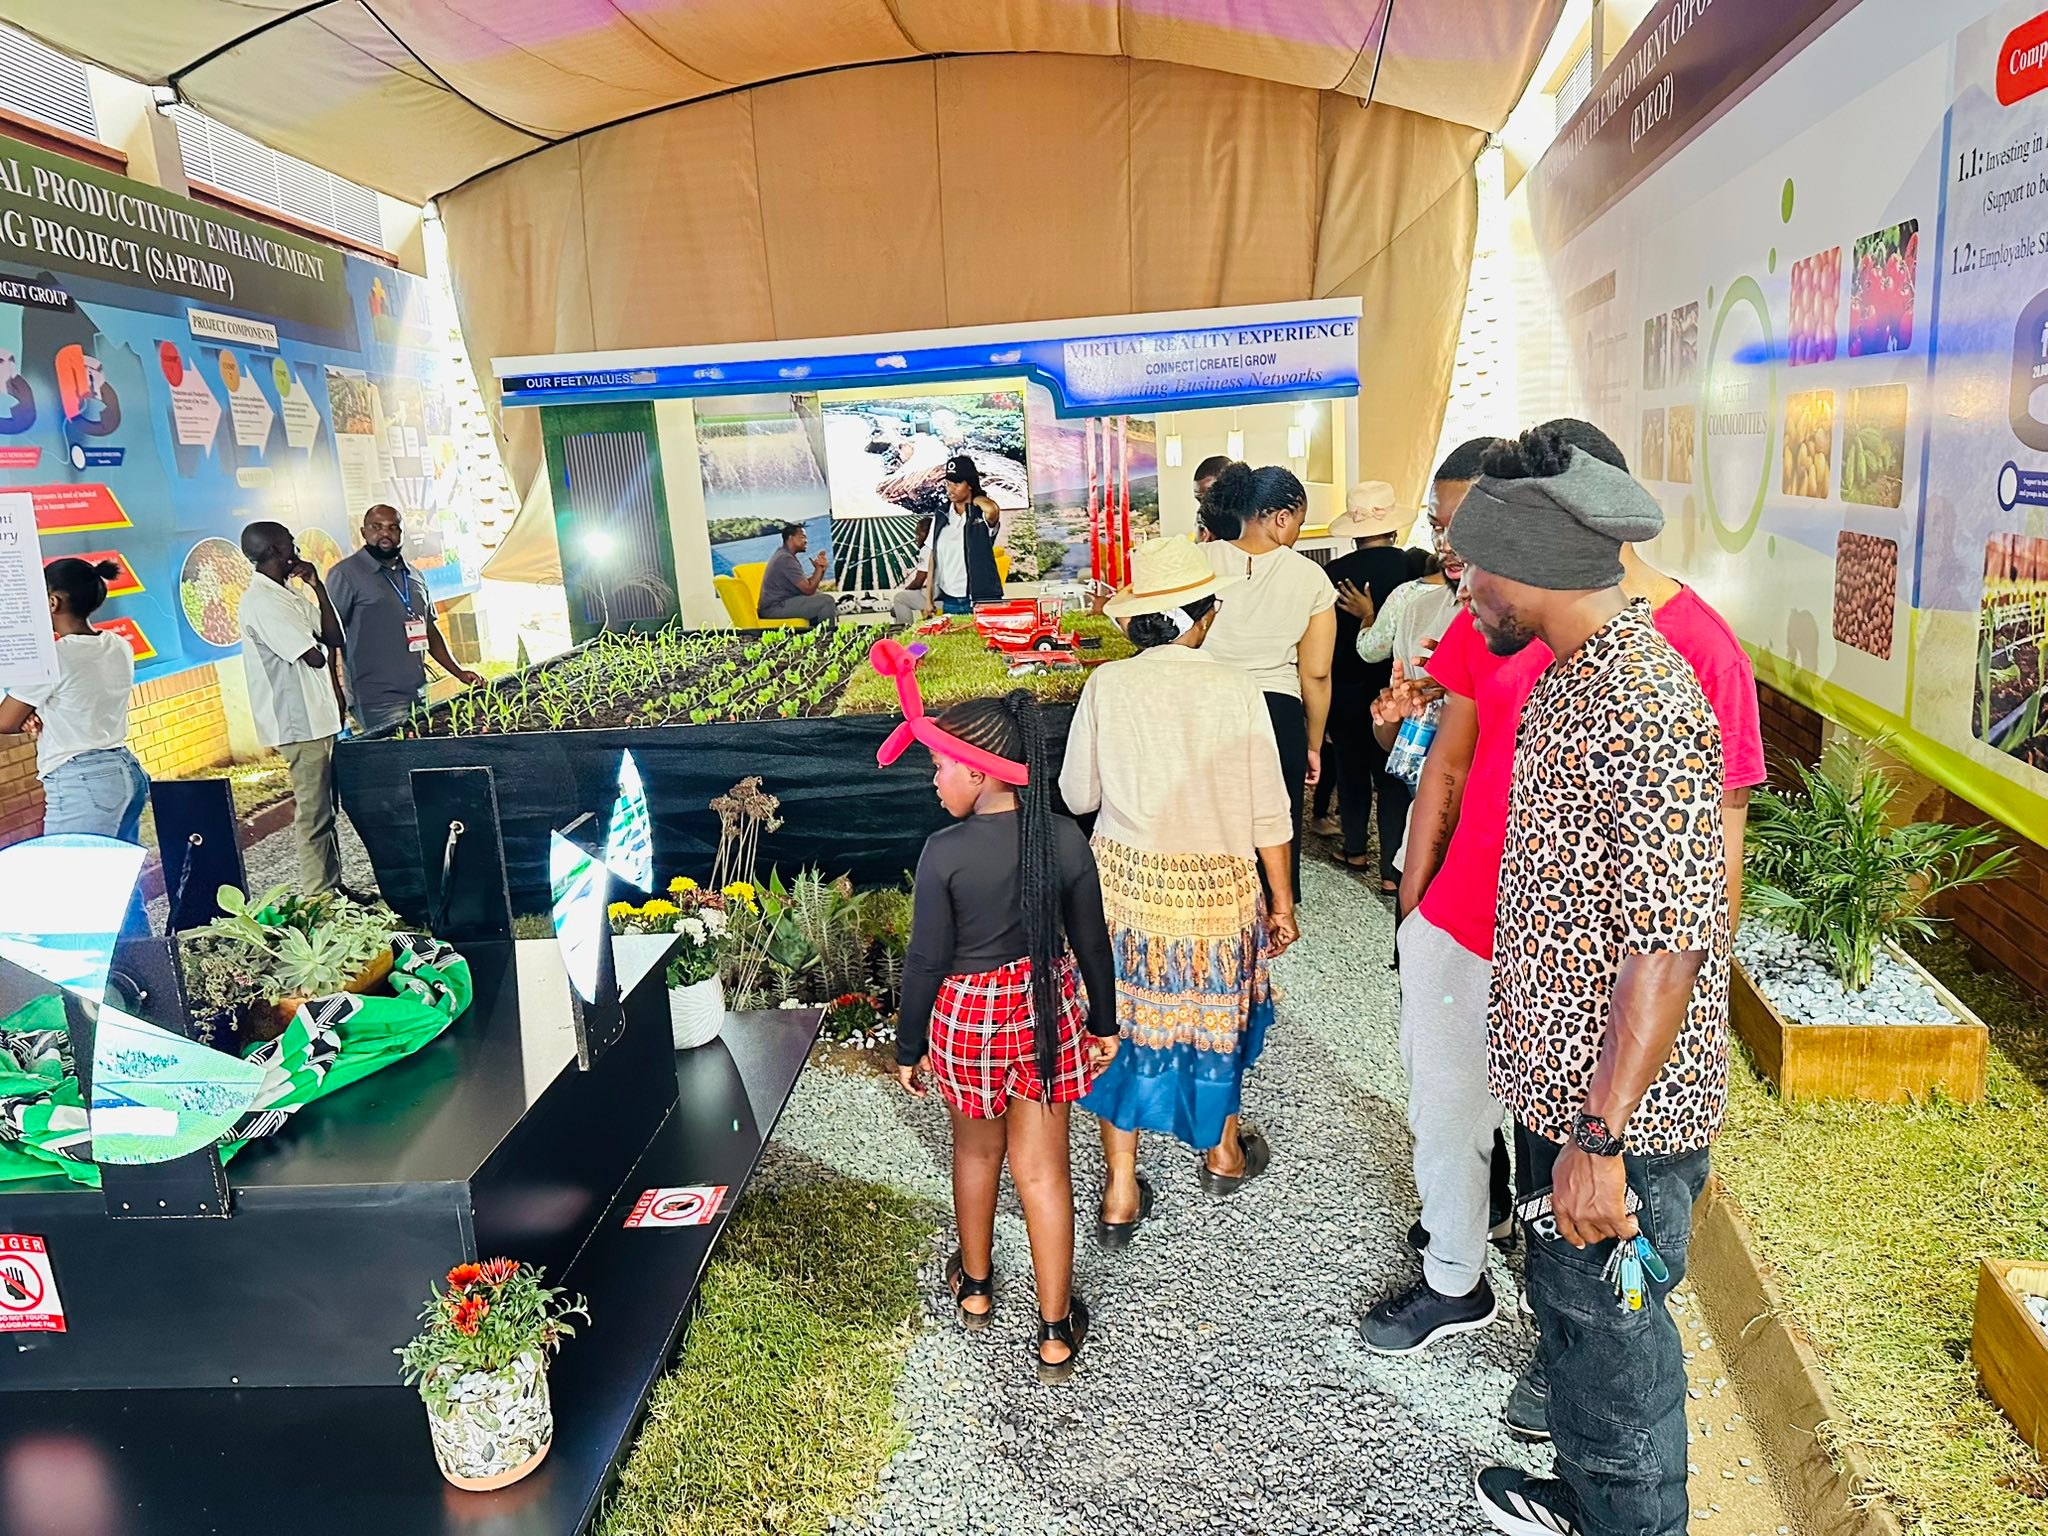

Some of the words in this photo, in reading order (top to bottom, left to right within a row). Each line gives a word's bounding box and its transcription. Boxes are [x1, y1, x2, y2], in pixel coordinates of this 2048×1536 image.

[1600, 14, 1670, 128] EMPLOYMENT
[2009, 40, 2048, 75] Comp
[1630, 71, 1674, 153] (EYEOP)
[1958, 147, 1983, 182] 1.1:
[1985, 140, 2030, 172] Investing
[2032, 132, 2042, 154] in
[1983, 185, 2024, 216] (Support
[2026, 180, 2037, 199] to
[31, 165, 202, 246] PRODUCTIVITY
[204, 220, 325, 282] ENHANCEMENT
[29, 215, 141, 274] PROJECT
[145, 246, 234, 301] (SAPEMP)
[1952, 242, 1976, 275] 1.2:
[1979, 236, 2036, 271] Employable
[28, 285, 67, 306] GROUP
[192, 315, 227, 334] PROJECT
[227, 322, 275, 341] COMPONENTS
[1068, 339, 1145, 359] VIRTUAL
[1154, 331, 1233, 353] REALITY
[1237, 321, 1354, 346] EXPERIENCE
[526, 377, 551, 389] OUR
[554, 375, 582, 387] FEET
[584, 373, 634, 386] VALUES:
[1146, 360, 1194, 375] CONNECT
[1200, 357, 1240, 371] CREATE
[1244, 353, 1277, 367] GROW
[1174, 375, 1243, 393] Business
[1249, 367, 1323, 388] Networks
[1707, 410, 1767, 436] COMMODITIES
[627, 1188, 658, 1227] DANGER
